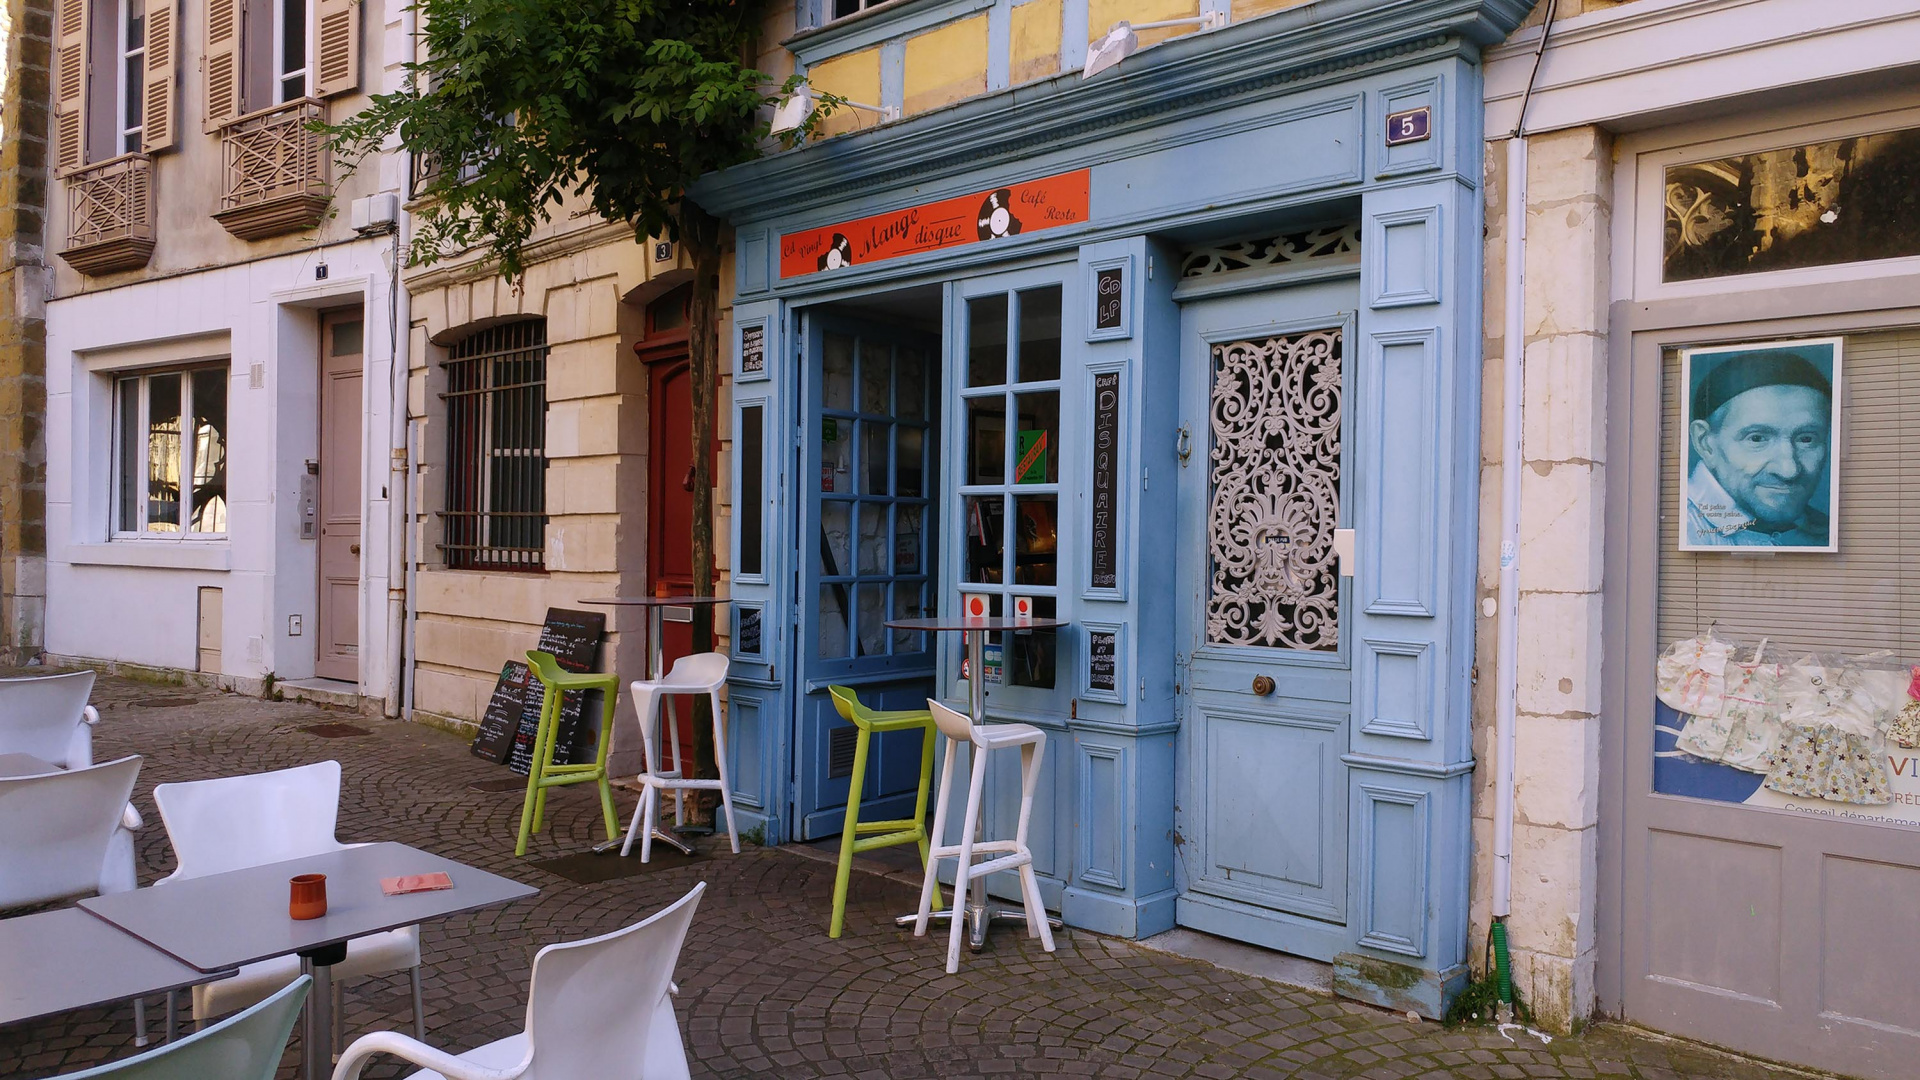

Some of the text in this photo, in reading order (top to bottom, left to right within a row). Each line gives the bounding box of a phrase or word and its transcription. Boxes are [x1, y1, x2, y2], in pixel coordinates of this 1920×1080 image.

[1401, 115, 1414, 136] 5
[1020, 189, 1048, 208] Café
[1044, 205, 1077, 221] Resto
[859, 208, 920, 259] Mange
[914, 223, 962, 247] disque
[660, 244, 666, 258] 3
[800, 234, 823, 259] Vinyl
[1098, 276, 1121, 295] CD
[1100, 299, 1120, 324] LP
[1094, 391, 1117, 569] DISQUAIRE
